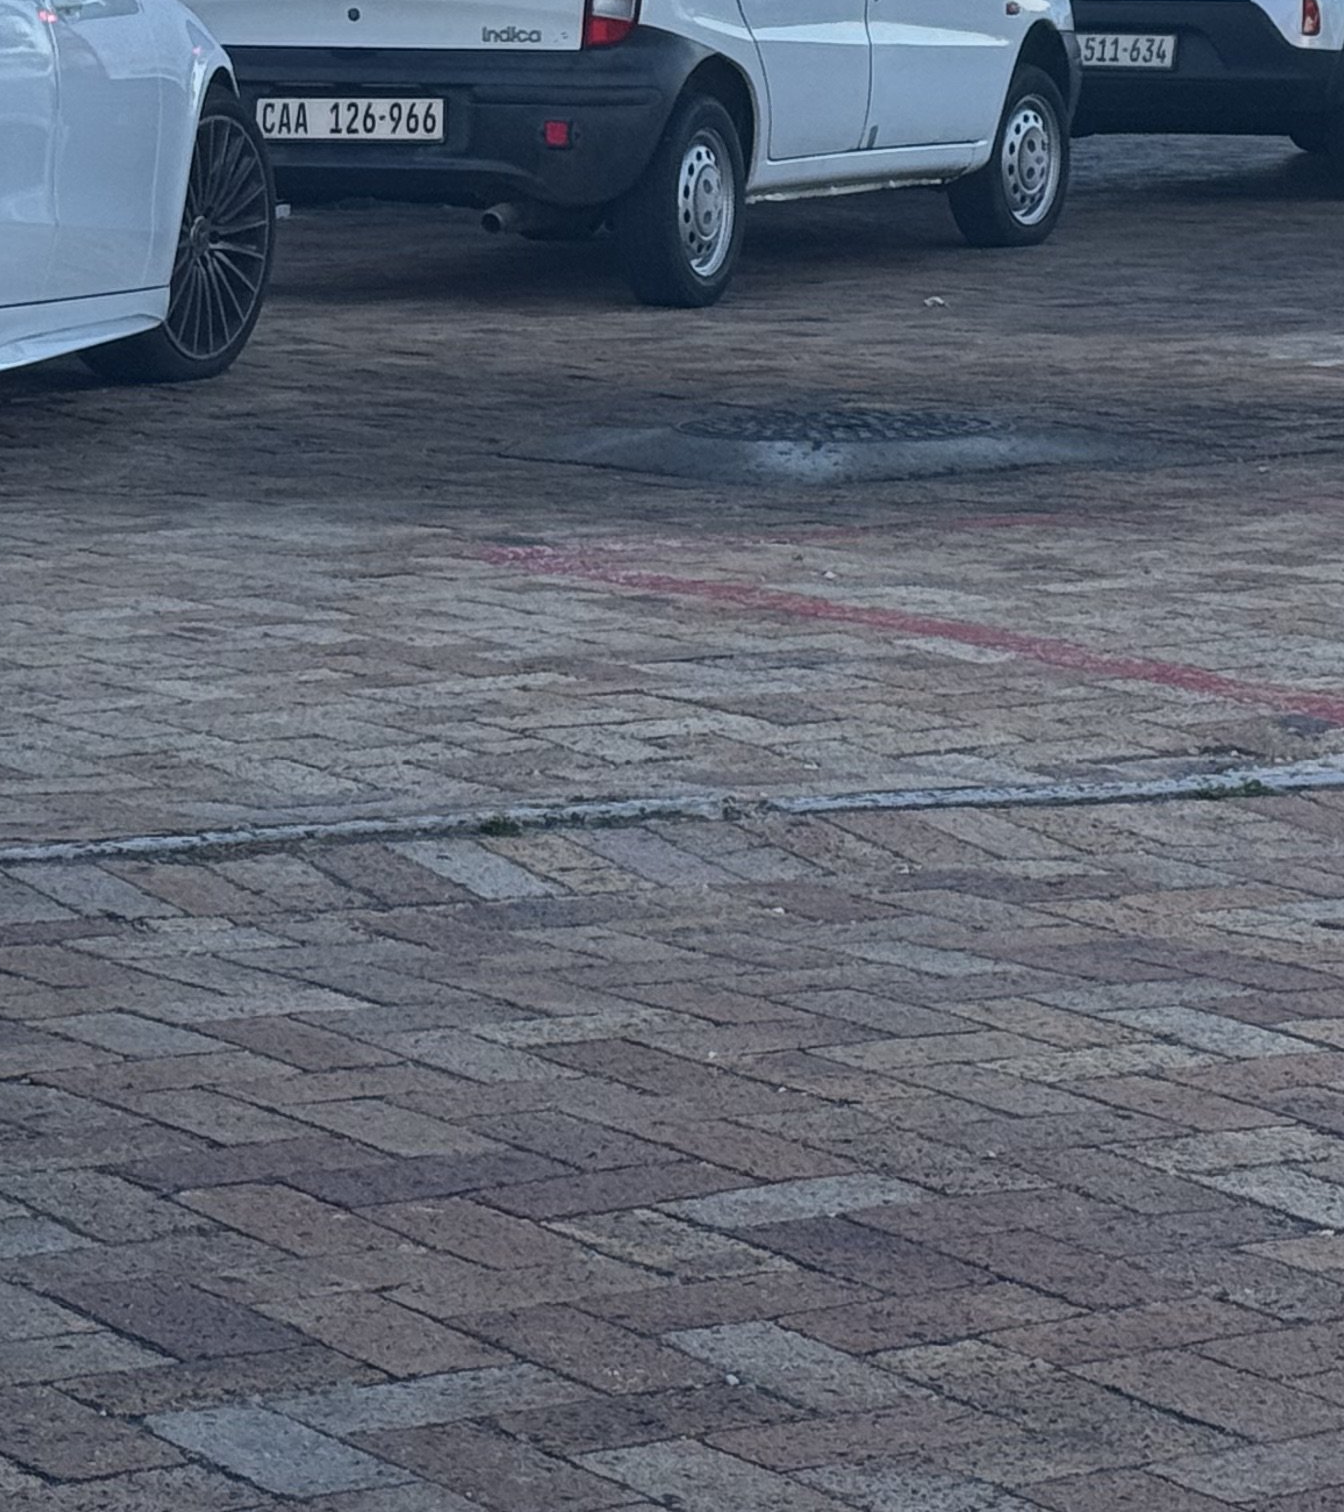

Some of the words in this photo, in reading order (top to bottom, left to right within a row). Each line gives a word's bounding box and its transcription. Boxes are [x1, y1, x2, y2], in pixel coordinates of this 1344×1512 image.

[1083, 38, 1166, 63] 511-634
[261, 102, 308, 134] CAA
[329, 102, 437, 134] 126-966
